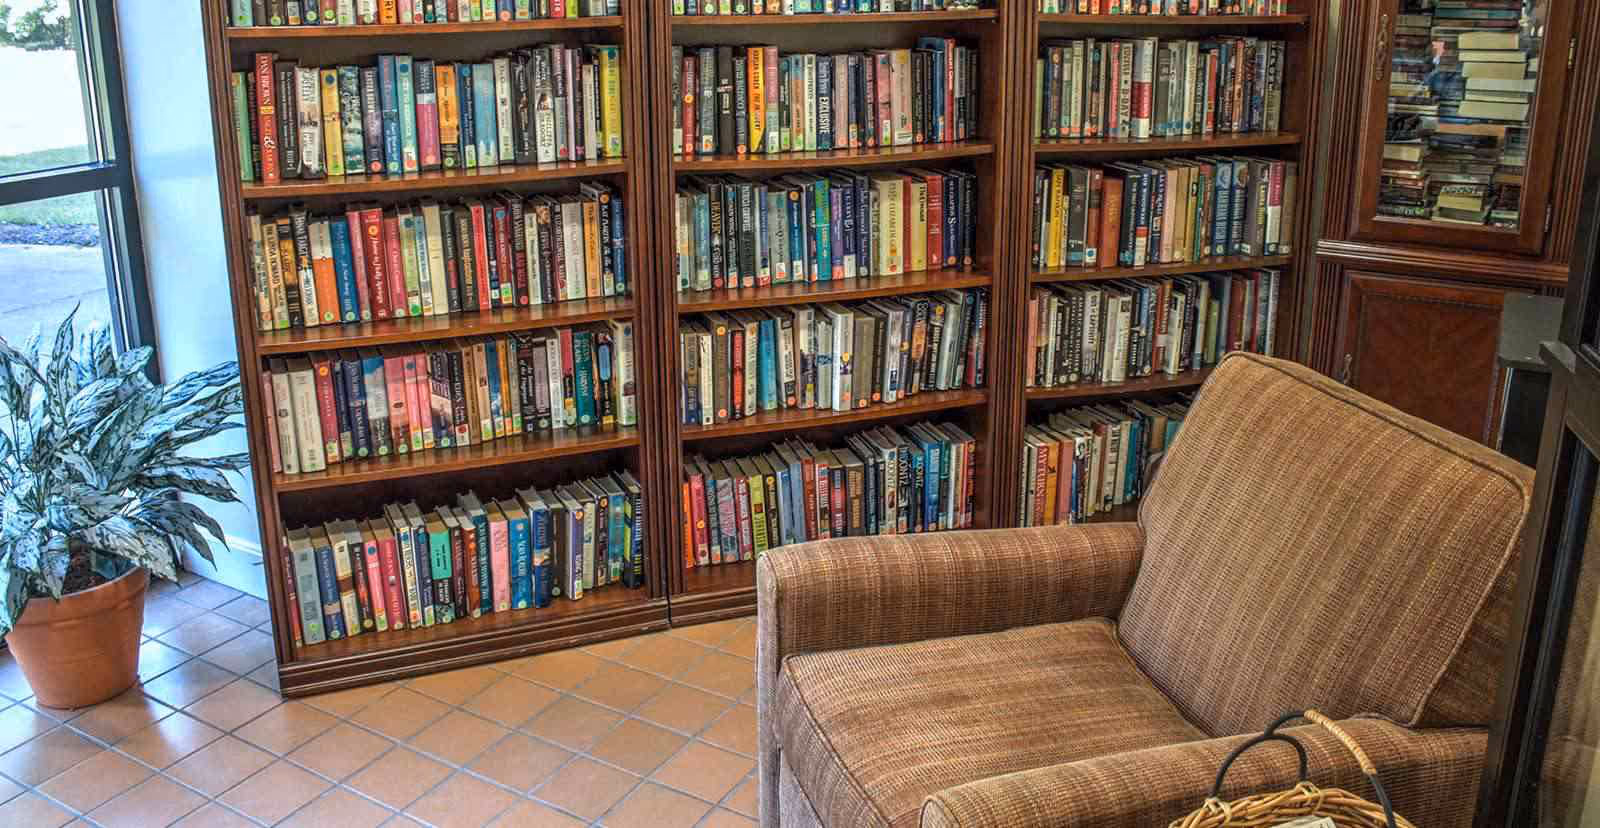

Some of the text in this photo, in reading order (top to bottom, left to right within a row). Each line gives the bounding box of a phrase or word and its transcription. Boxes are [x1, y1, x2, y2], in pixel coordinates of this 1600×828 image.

[260, 56, 269, 74] DAN
[262, 76, 271, 106] BROWN
[819, 97, 830, 135] EXCLUSIVE
[712, 201, 721, 234] DEAVER
[1088, 314, 1097, 345] CAPTIVITY
[1038, 447, 1048, 463] MY
[1036, 468, 1048, 497] TURN
